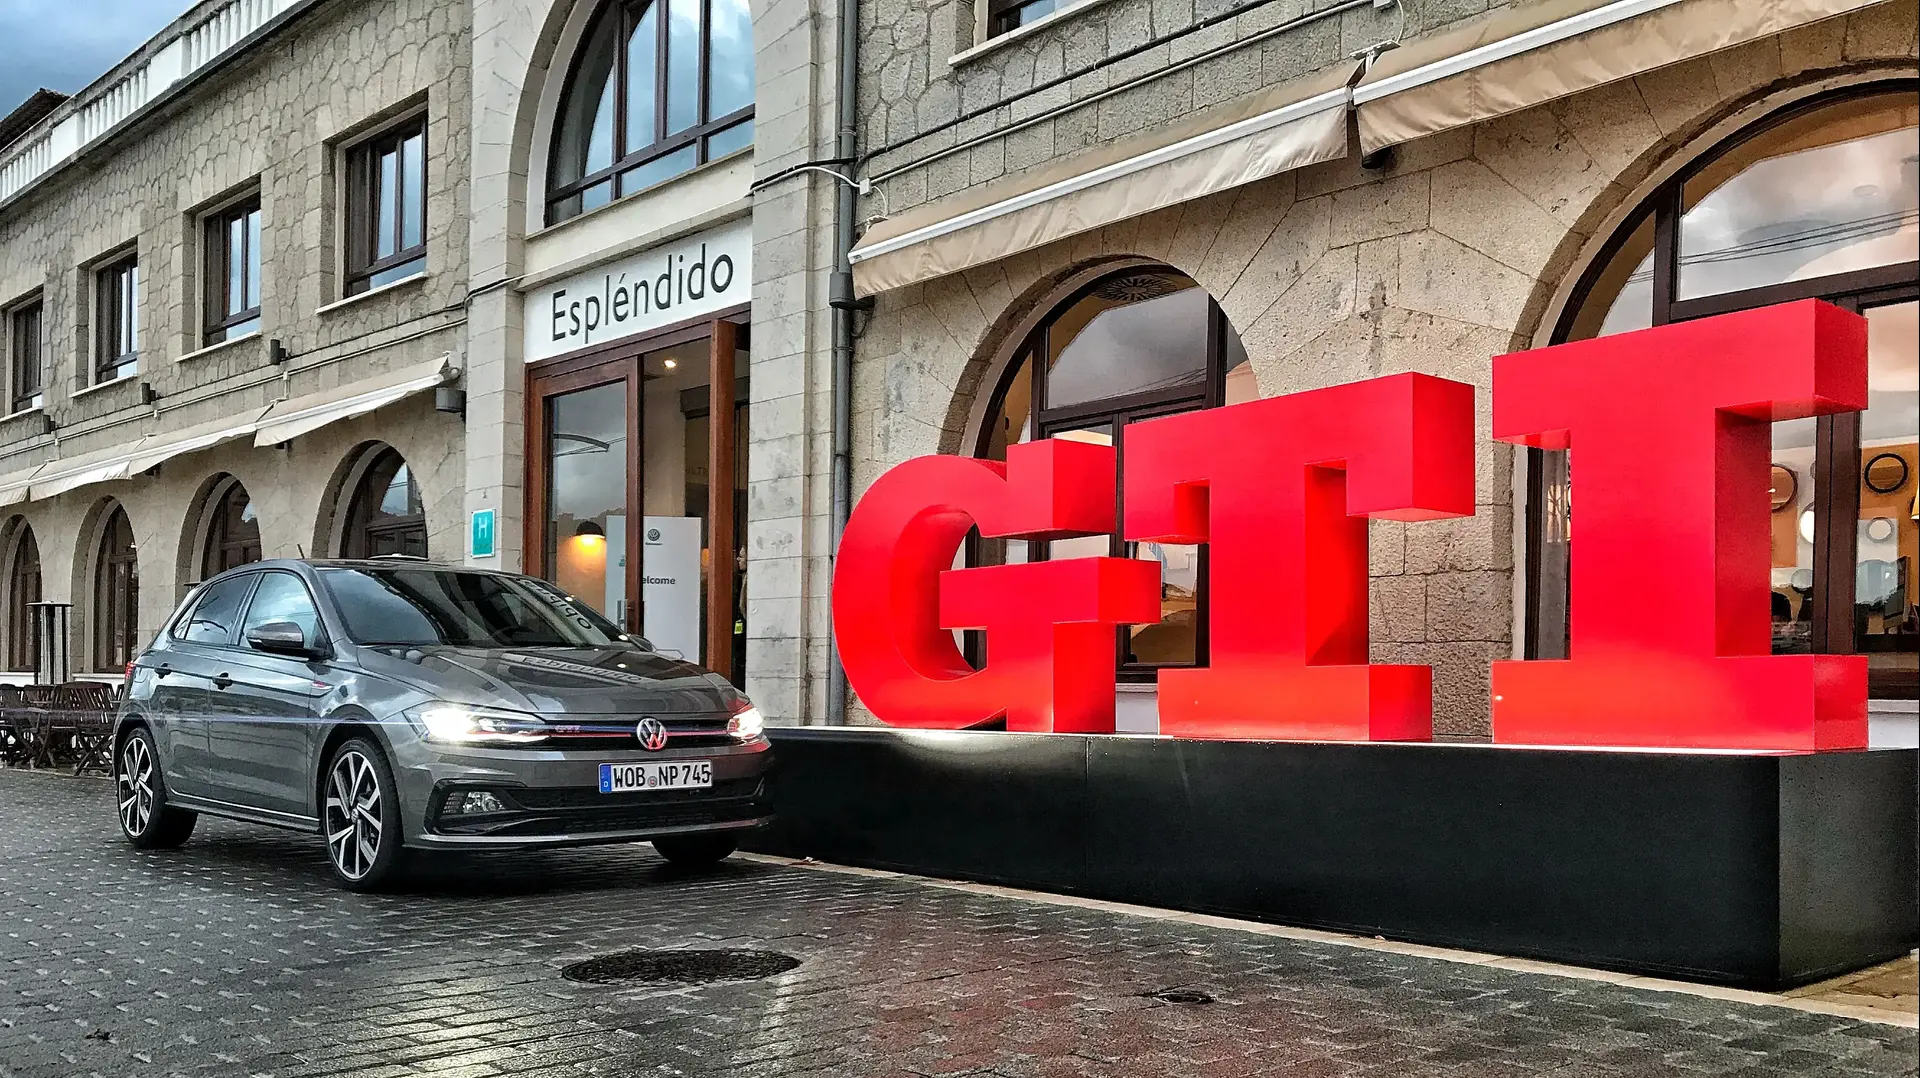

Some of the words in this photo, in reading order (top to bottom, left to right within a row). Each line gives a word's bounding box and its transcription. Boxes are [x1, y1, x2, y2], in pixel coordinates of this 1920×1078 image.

[552, 243, 734, 344] Espléndido
[478, 516, 488, 539] H
[832, 298, 1868, 752] GTI
[642, 575, 676, 585] elcome
[613, 766, 646, 788] WOB
[658, 765, 679, 786] NP
[682, 764, 712, 785] 745
